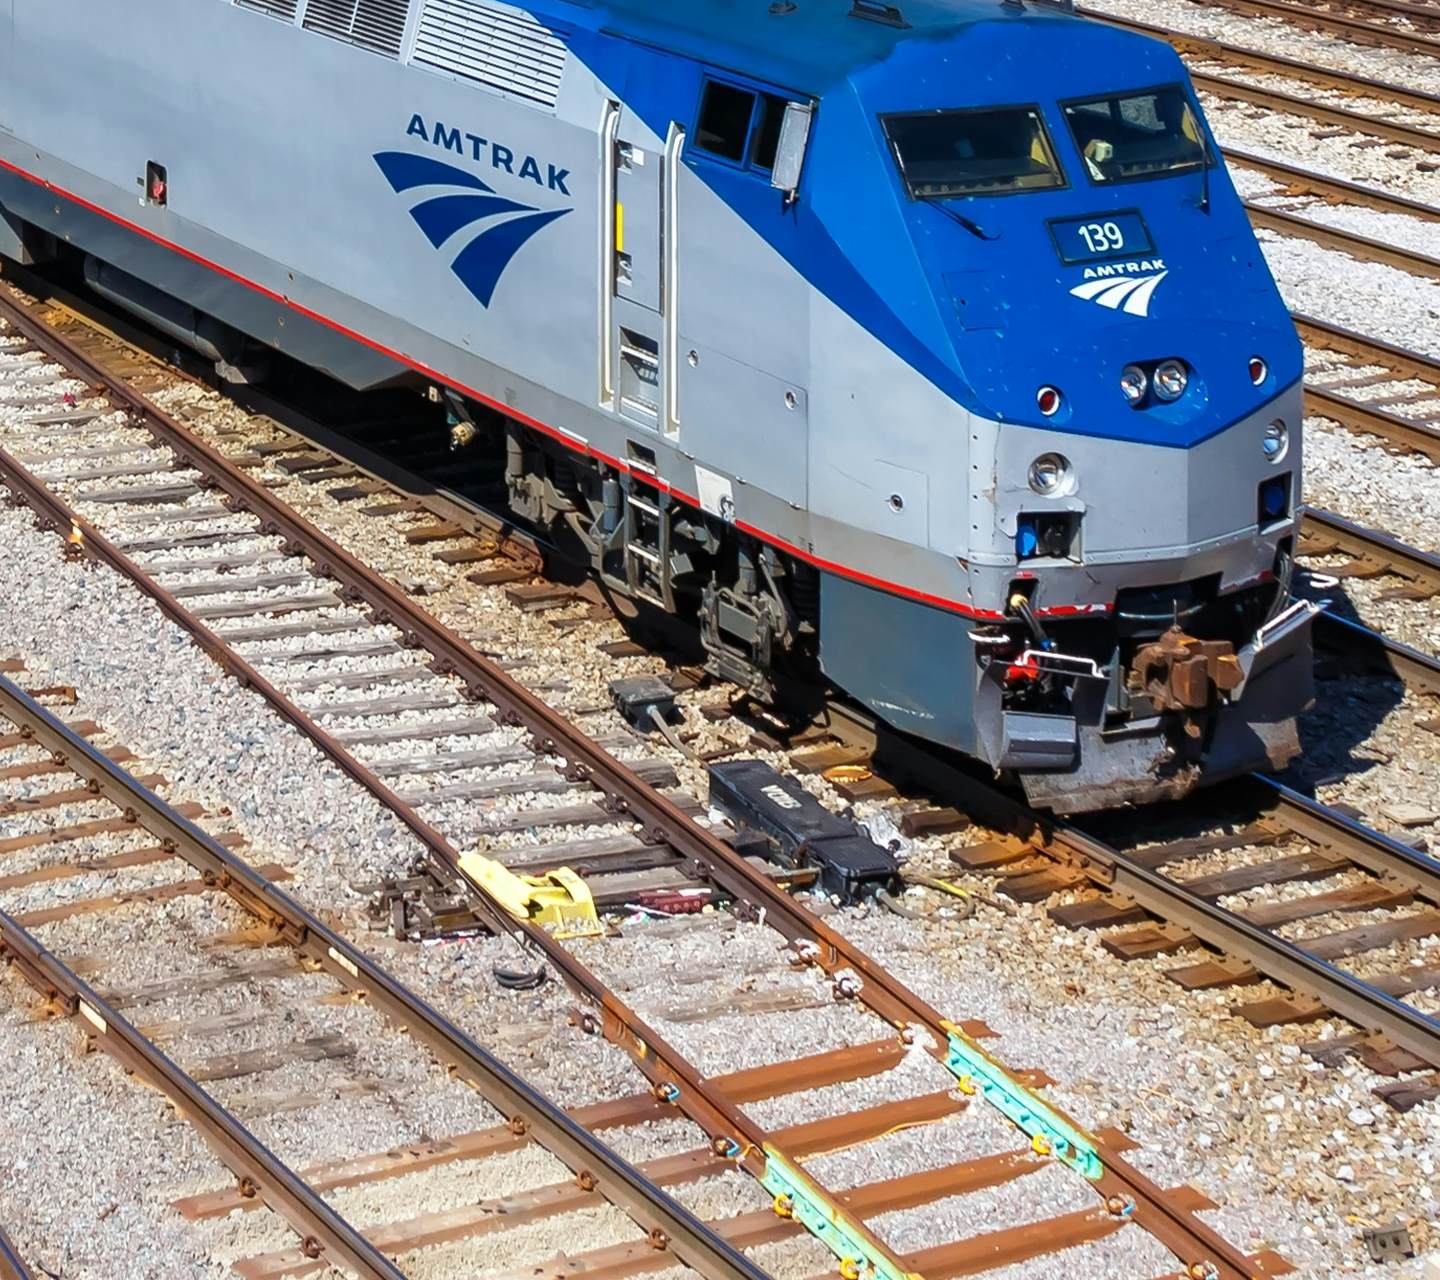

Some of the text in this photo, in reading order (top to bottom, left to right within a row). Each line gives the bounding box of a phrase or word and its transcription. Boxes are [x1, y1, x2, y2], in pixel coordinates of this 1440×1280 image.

[406, 113, 571, 196] AMTRAK
[1078, 222, 1124, 252] 139
[1083, 259, 1166, 279] AMTRAK
